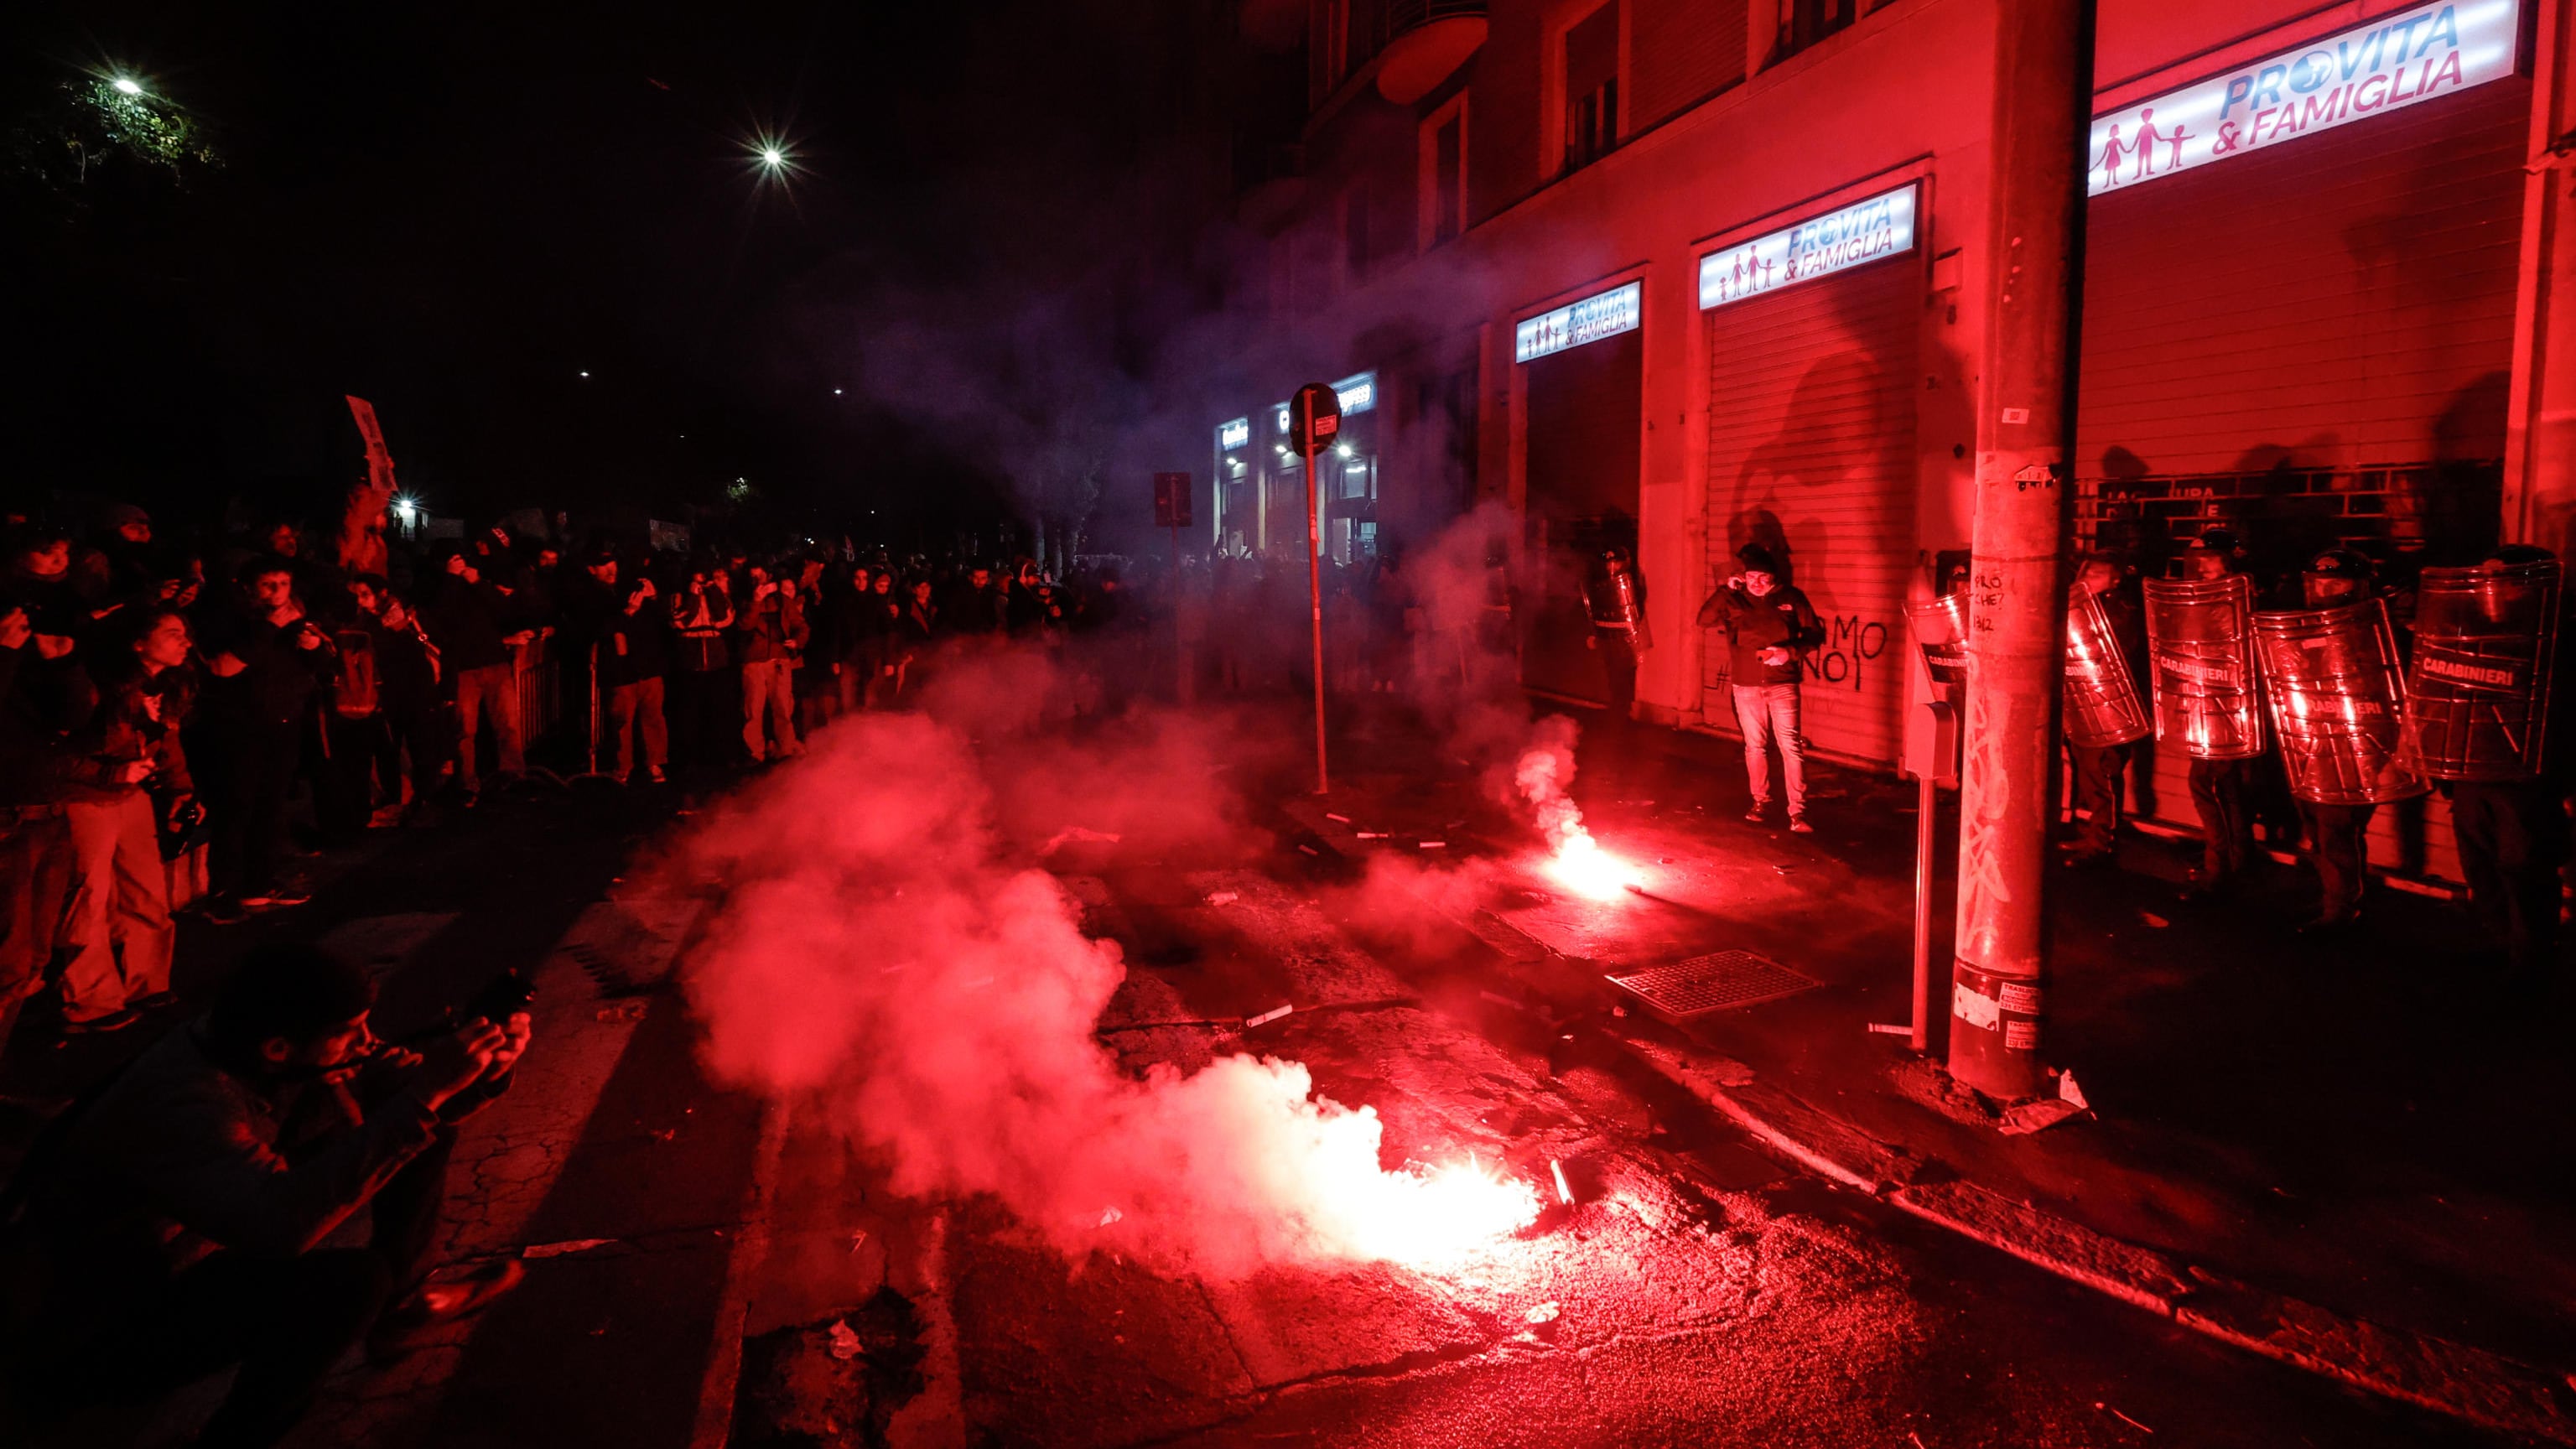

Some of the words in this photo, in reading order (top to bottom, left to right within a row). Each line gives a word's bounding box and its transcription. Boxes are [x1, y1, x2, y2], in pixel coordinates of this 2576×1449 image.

[2220, 5, 2459, 121] PROVITA
[2212, 121, 2241, 155] &
[2248, 50, 2463, 146] FAMIGLIA
[1787, 198, 1891, 258] PROVITA
[1784, 259, 1797, 281] &
[1800, 227, 1893, 277] FAMIGLIA
[1565, 330, 1573, 345] &
[1574, 311, 1628, 343] FAMIGLIA
[1567, 290, 1626, 328] PROVITA
[2160, 656, 2228, 682] CARABINIERI
[2423, 657, 2513, 686] CARABINIERI
